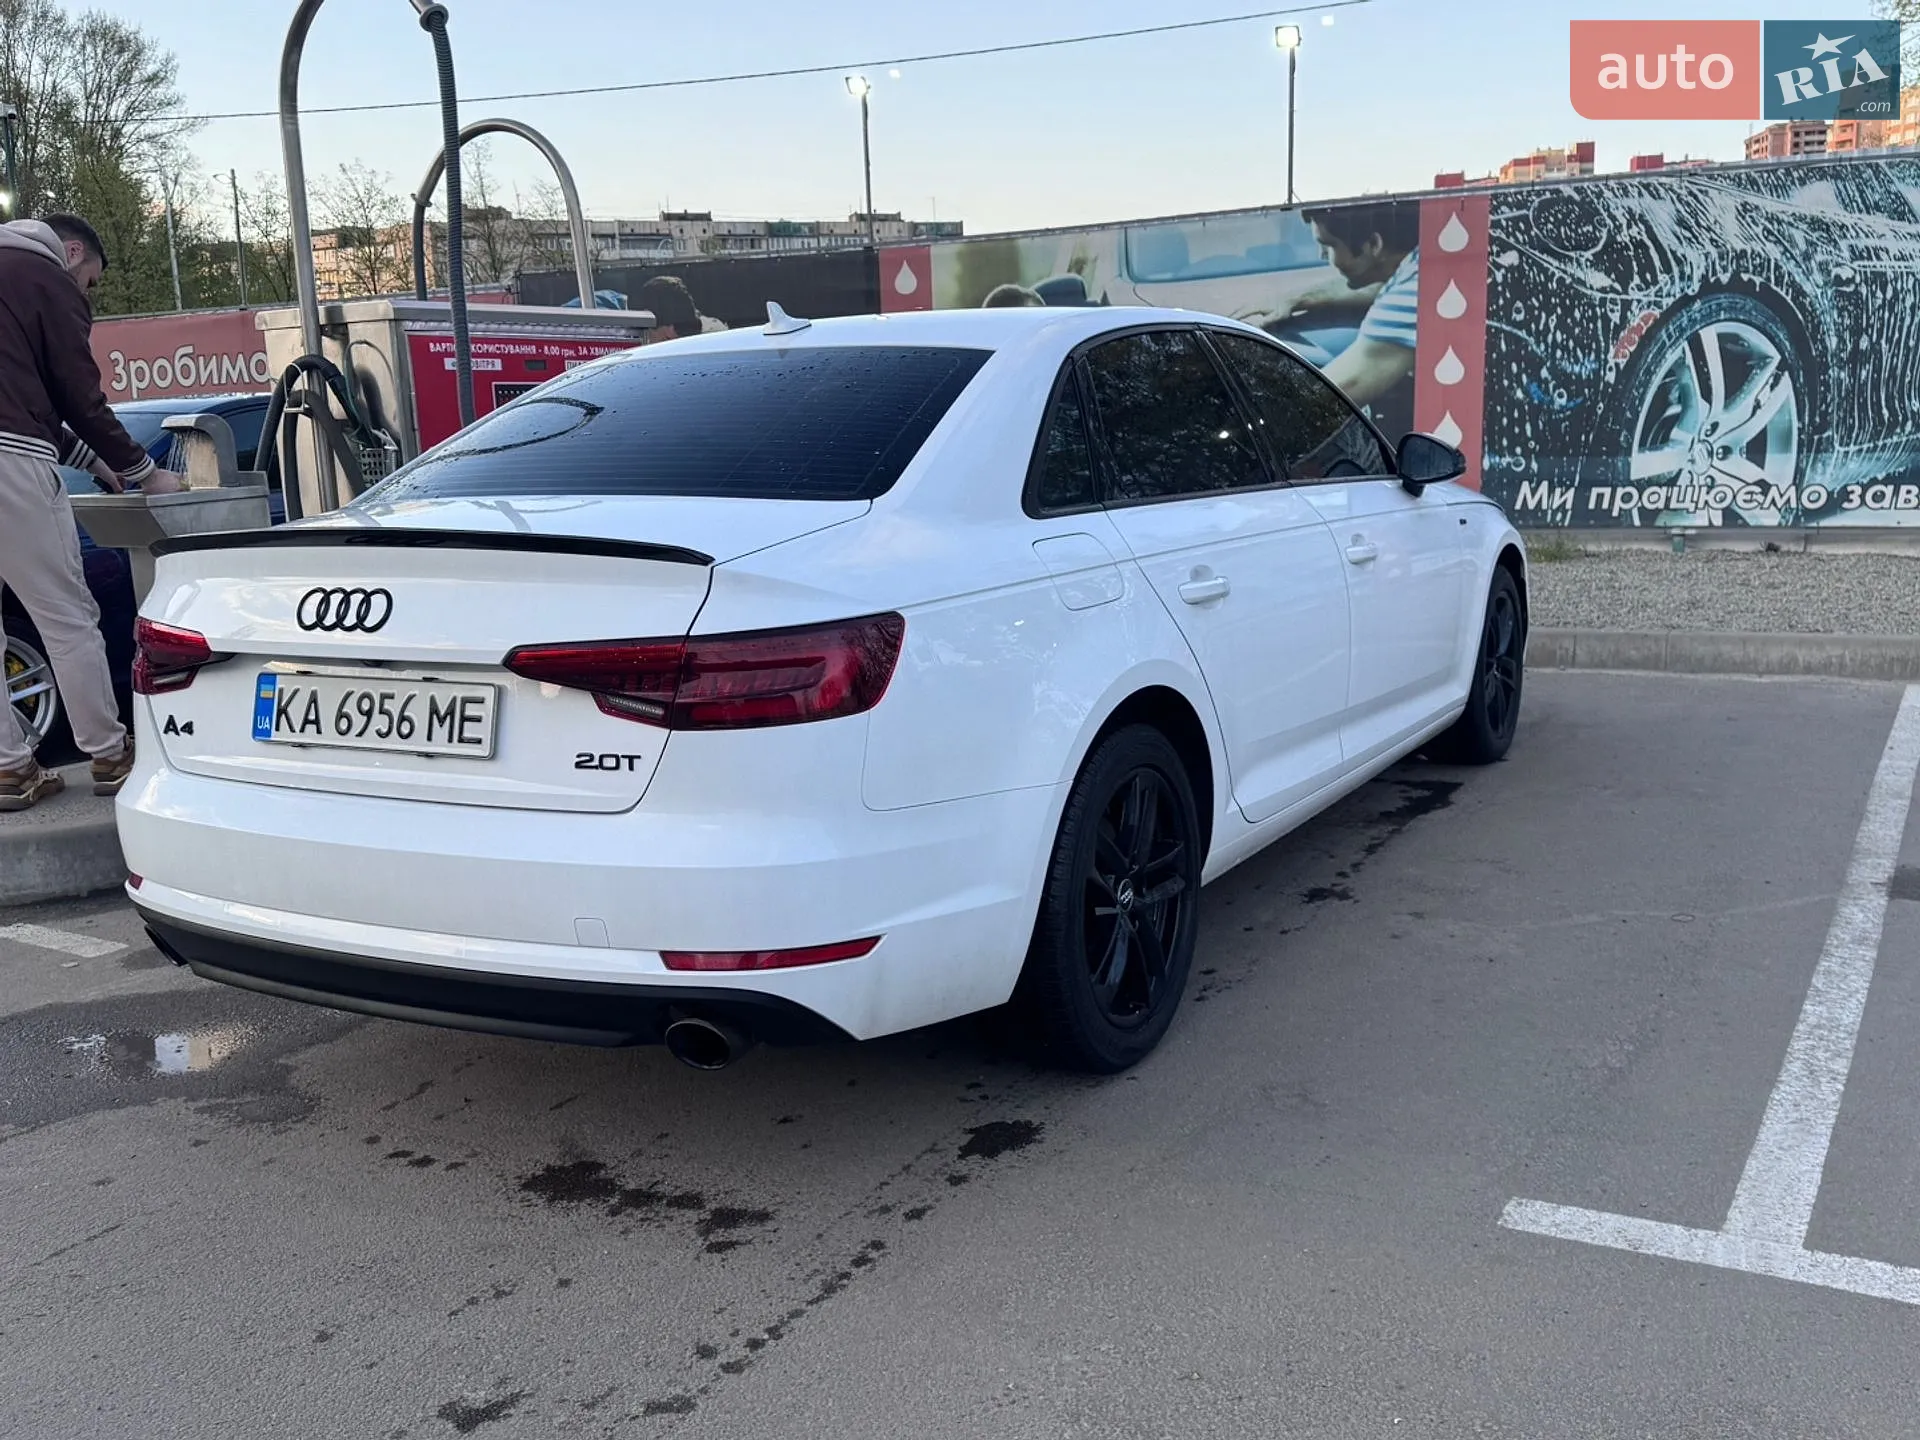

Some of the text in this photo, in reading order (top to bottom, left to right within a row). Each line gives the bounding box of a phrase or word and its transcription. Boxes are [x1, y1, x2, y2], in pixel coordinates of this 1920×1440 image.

[470, 343, 536, 354] КОРИСТУВАННЯ
[108, 344, 269, 399] Зробимо
[1514, 480, 1920, 518] Ми працюємо зав
[163, 714, 194, 736] A4
[257, 715, 271, 731] UA
[274, 686, 486, 745] KA 6956 ME
